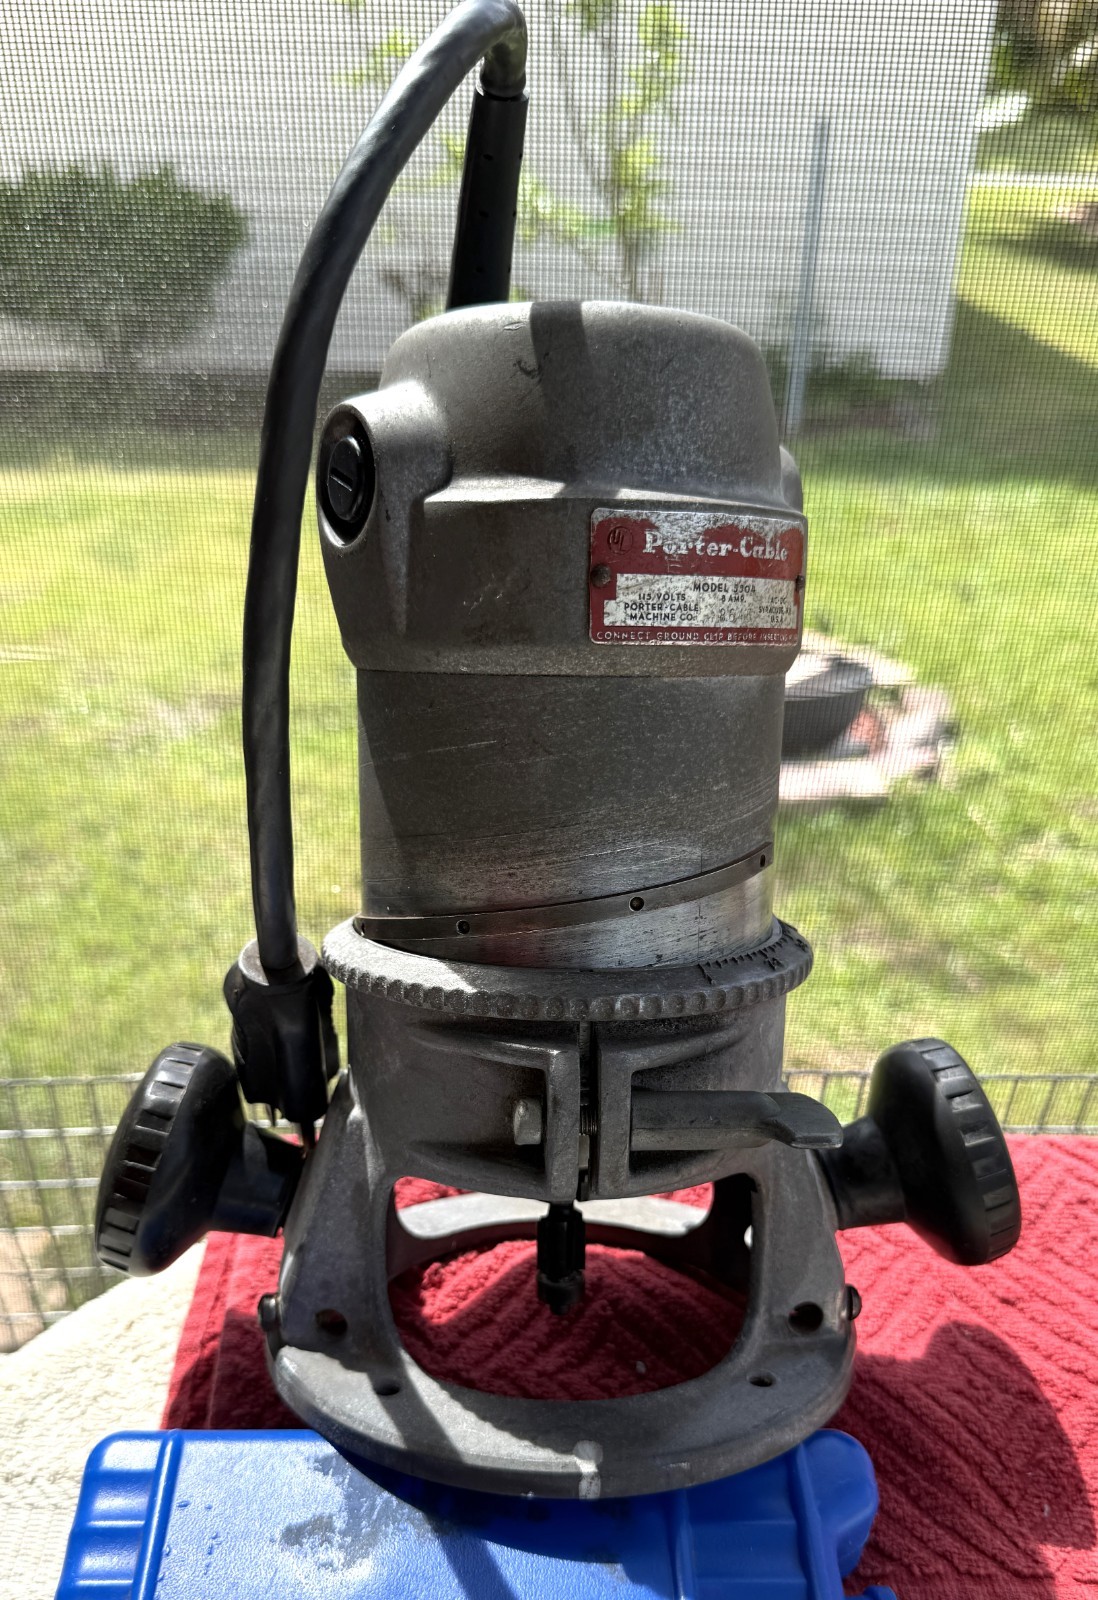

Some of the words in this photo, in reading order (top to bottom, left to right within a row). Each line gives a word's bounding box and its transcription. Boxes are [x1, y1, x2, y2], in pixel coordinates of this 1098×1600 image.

[643, 529, 788, 562] Porter-Cable
[693, 582, 729, 593] MODEL
[638, 592, 652, 601] 115
[656, 592, 686, 601] VOLTS
[624, 602, 699, 612] PORTER-CABLE
[630, 612, 676, 621] MACHINE
[596, 631, 651, 640] CONNECT
[656, 631, 699, 640] GROUND
